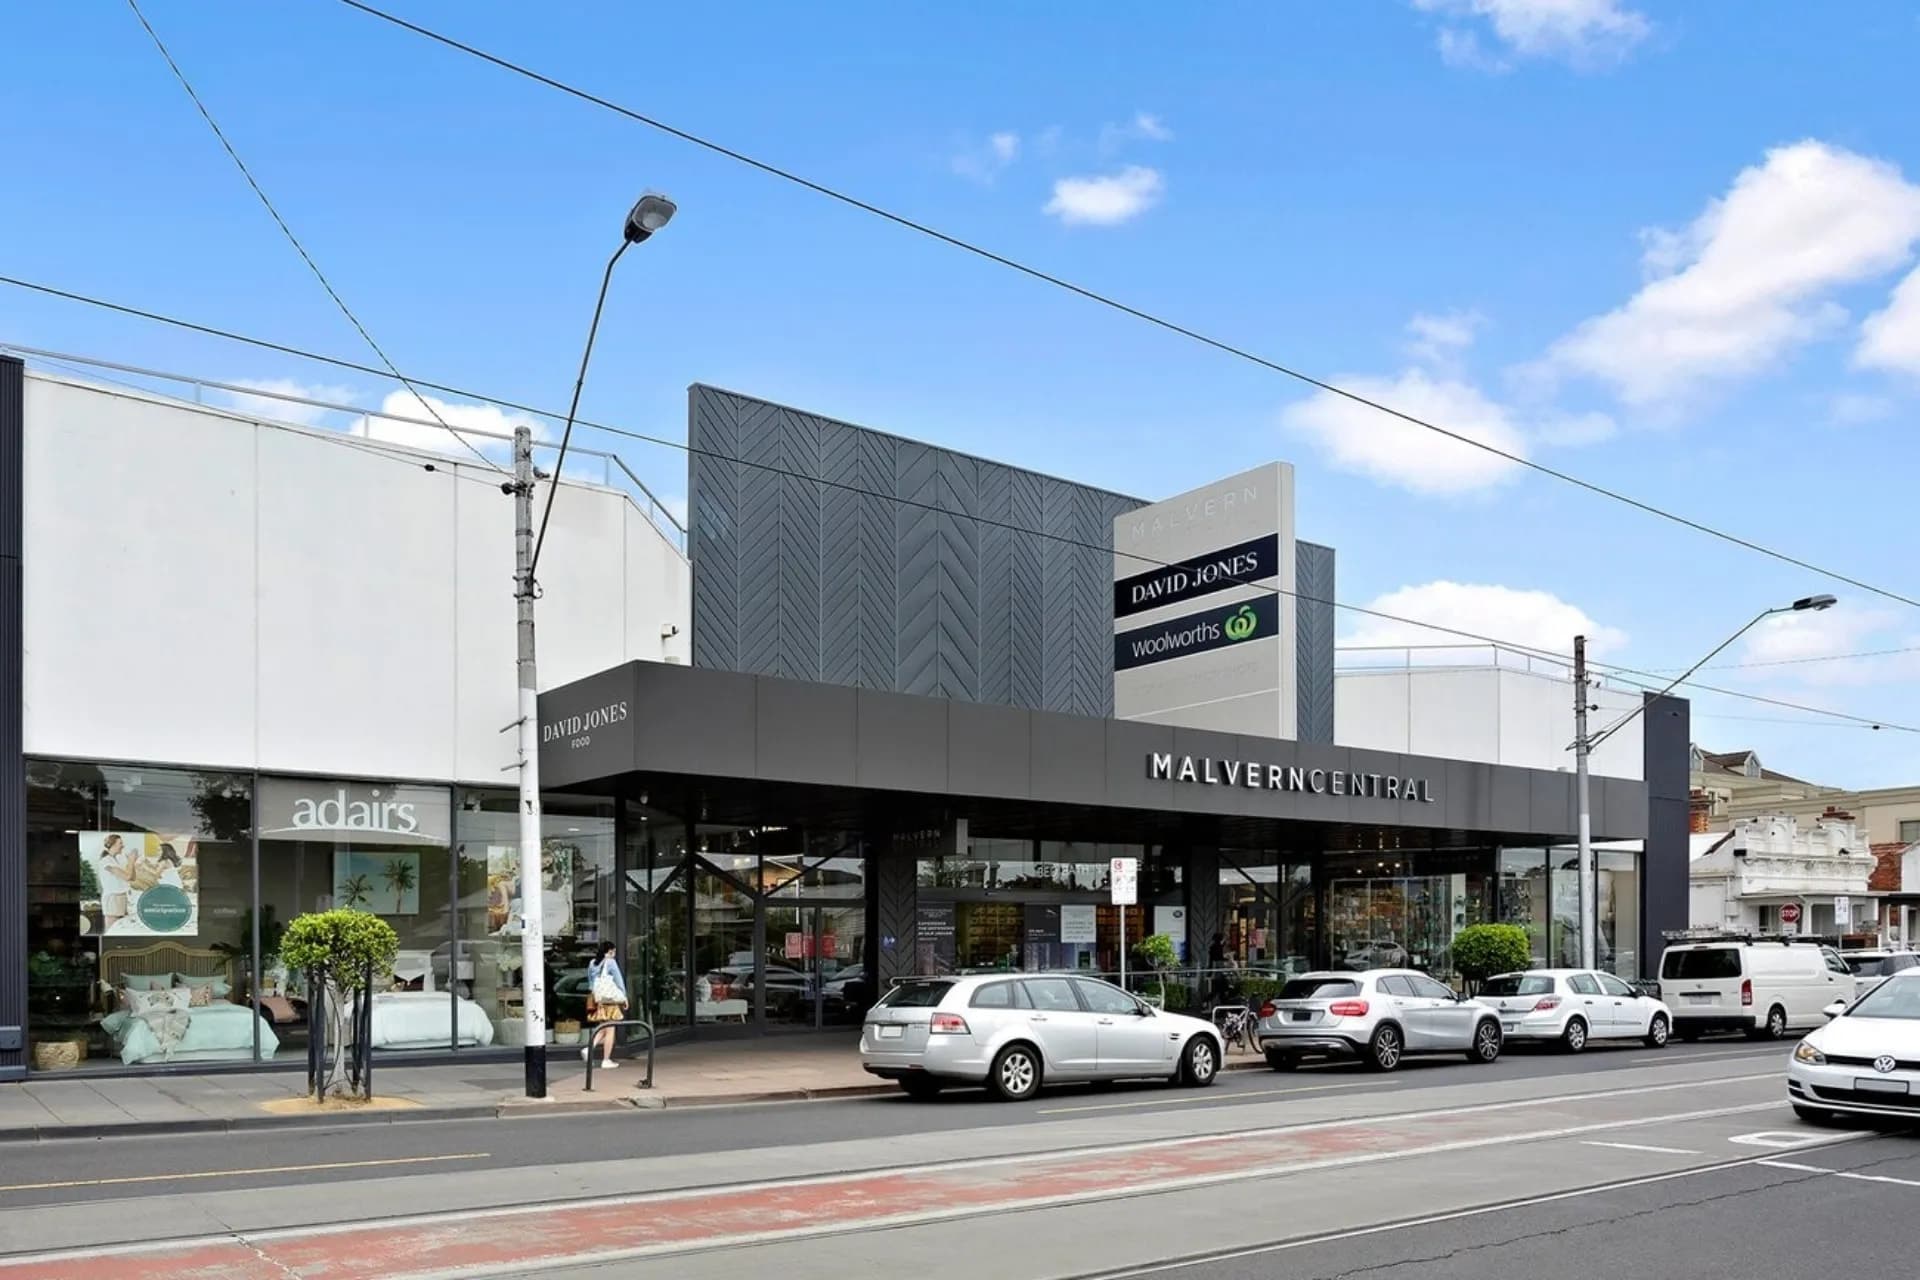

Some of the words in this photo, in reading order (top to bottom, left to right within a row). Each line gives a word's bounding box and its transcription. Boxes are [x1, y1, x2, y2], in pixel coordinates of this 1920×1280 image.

[1131, 487, 1257, 539] MALVERN
[1132, 572, 1188, 603] DAVID
[1192, 551, 1258, 587] JONES
[543, 715, 581, 743] DAVID
[583, 701, 627, 731] JONES
[571, 735, 591, 749] FOOD
[292, 789, 417, 833] adairs
[1782, 909, 1799, 918] STOP
